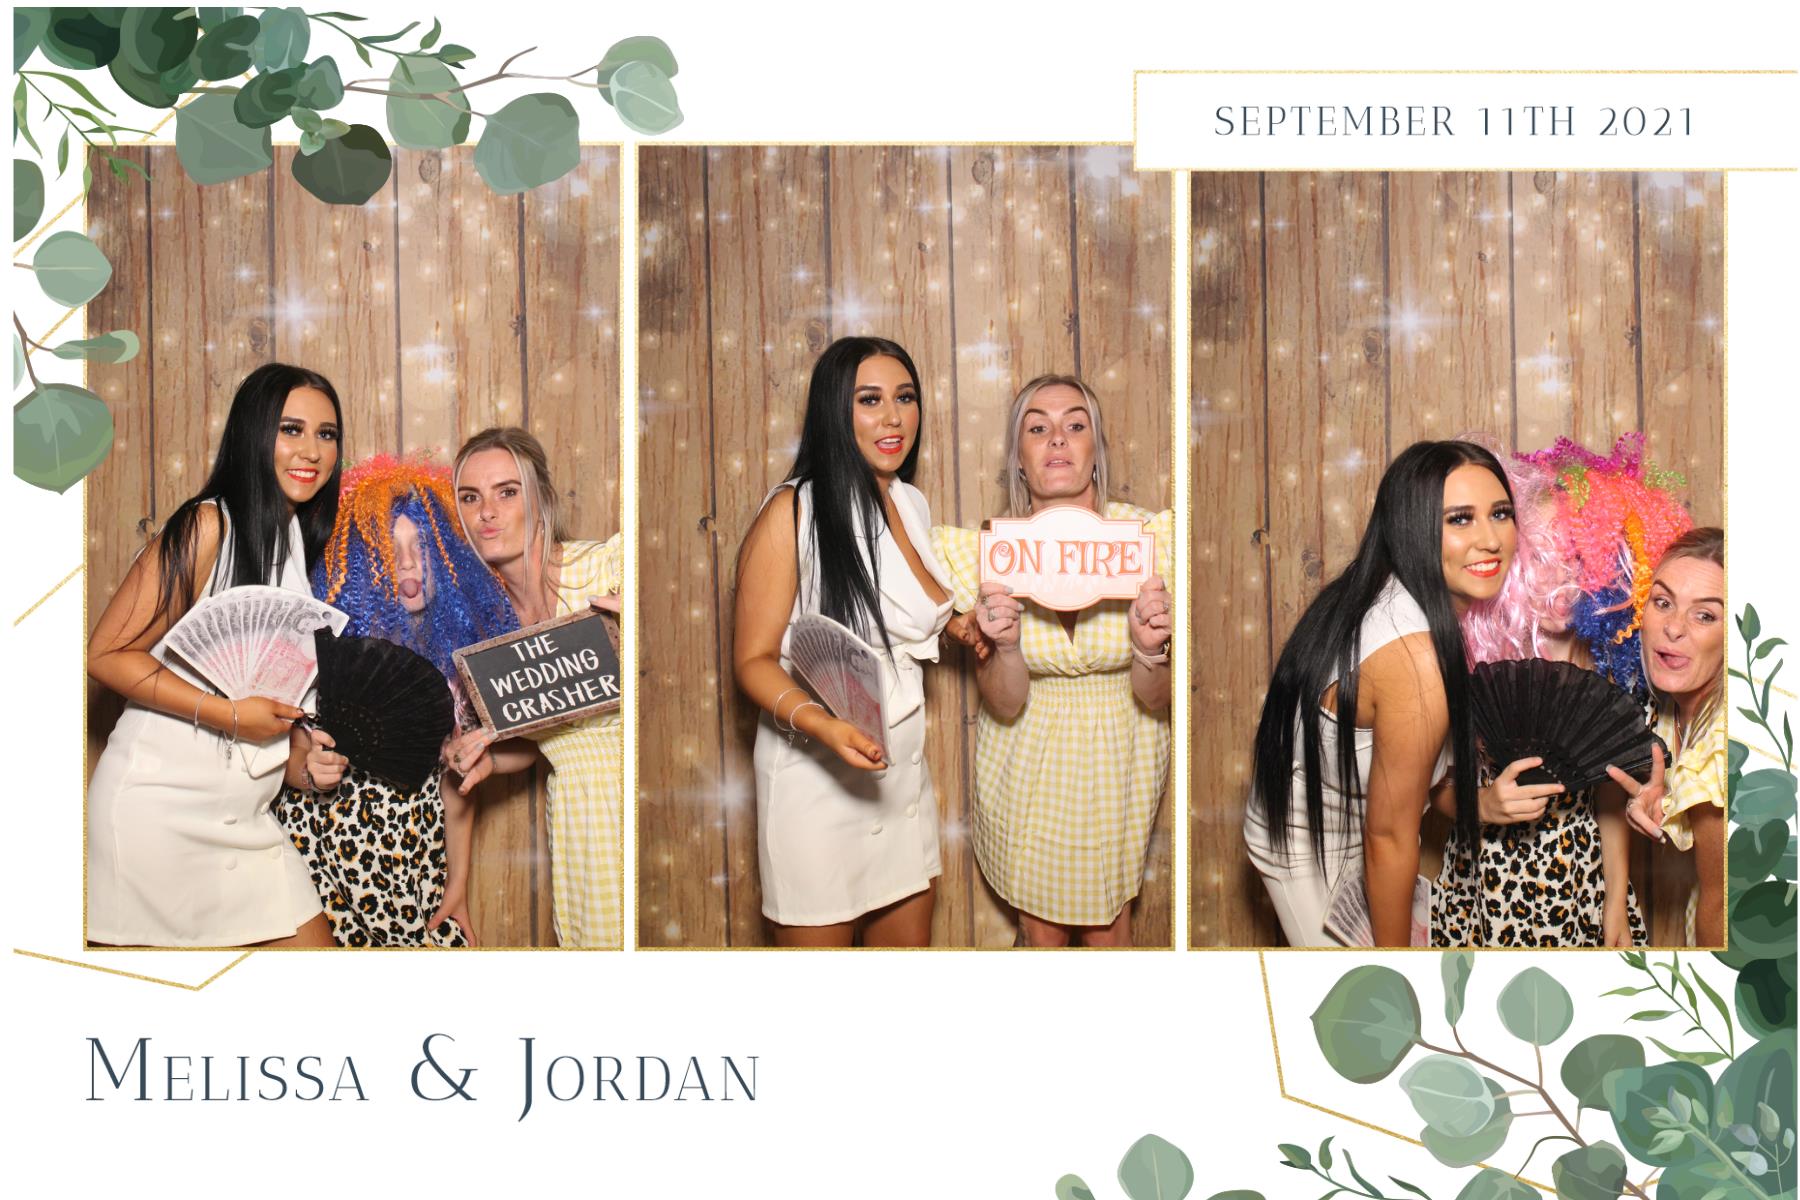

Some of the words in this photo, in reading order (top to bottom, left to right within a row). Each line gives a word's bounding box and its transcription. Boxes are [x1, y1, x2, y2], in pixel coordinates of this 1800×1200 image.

[989, 539, 1045, 576] ON
[1056, 540, 1143, 578] FIRE
[510, 633, 559, 662] THE
[489, 648, 599, 698] WEDDING
[502, 674, 620, 722] CRASHER
